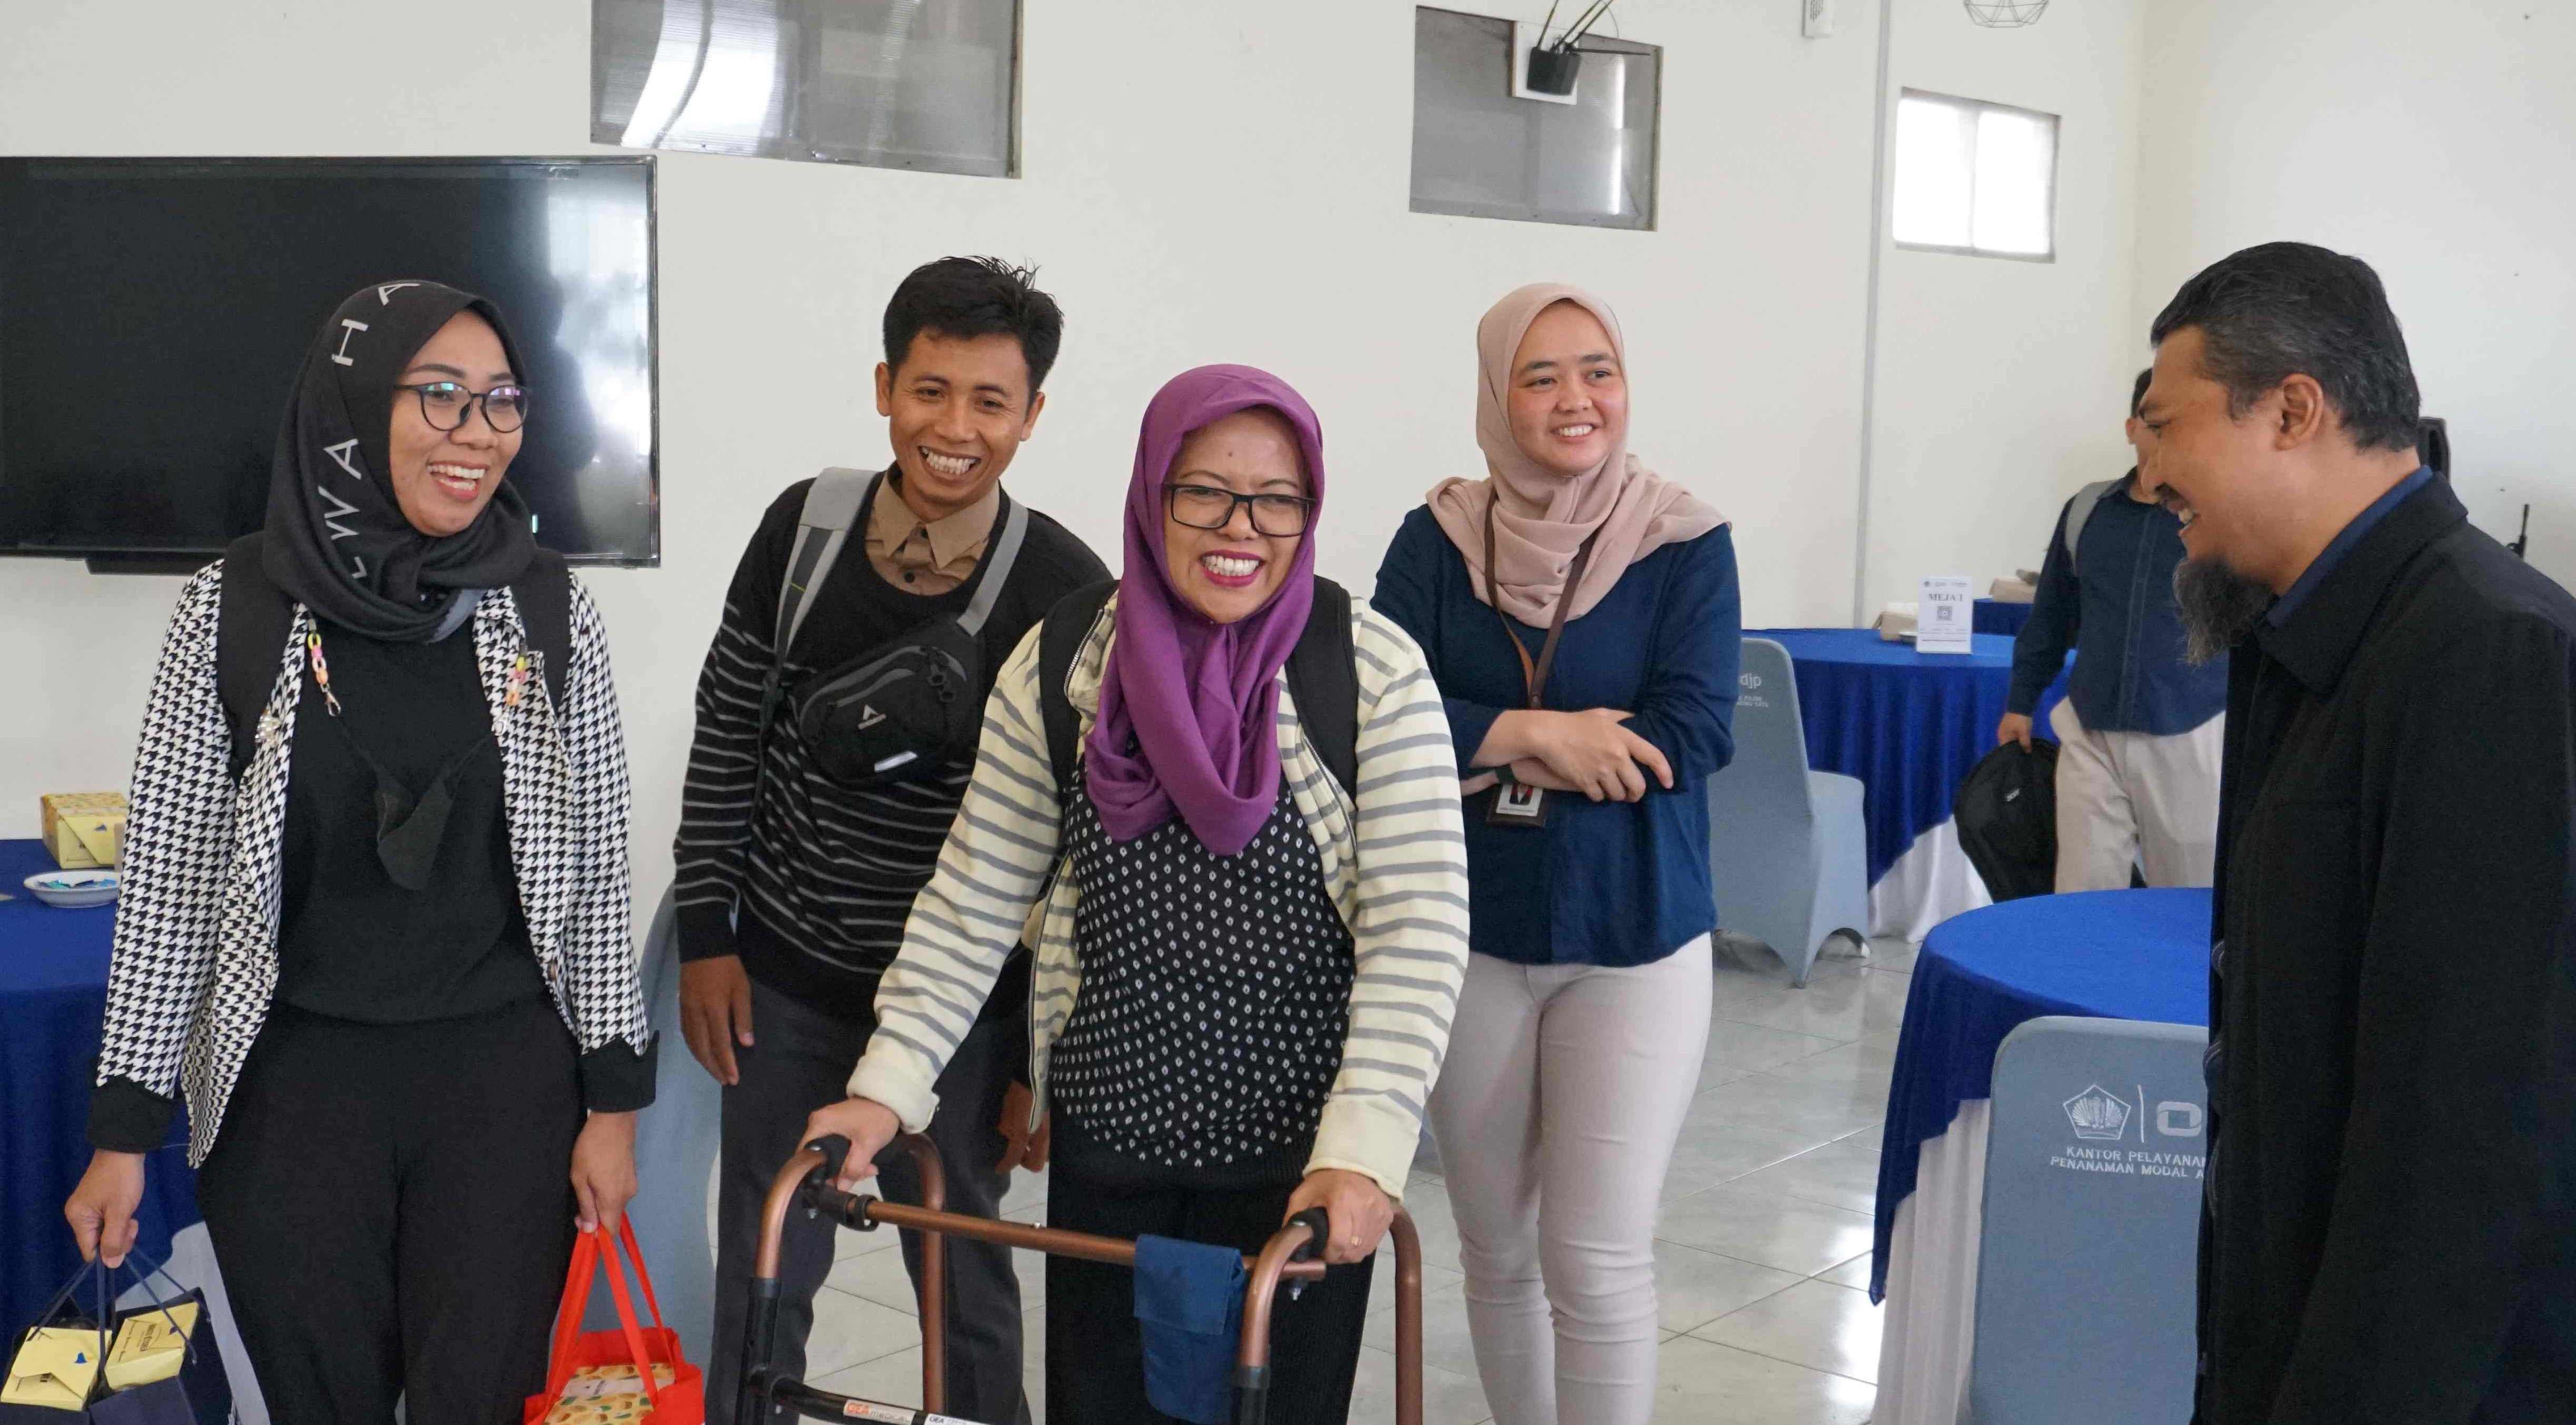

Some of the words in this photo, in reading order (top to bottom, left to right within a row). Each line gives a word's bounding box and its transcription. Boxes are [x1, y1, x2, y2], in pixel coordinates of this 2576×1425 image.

[2066, 1146, 2121, 1161] KANTOR
[2051, 1156, 2134, 1174] PENANAMAN
[2141, 1164, 2188, 1177] MODAL
[847, 1402, 869, 1414] GEA
